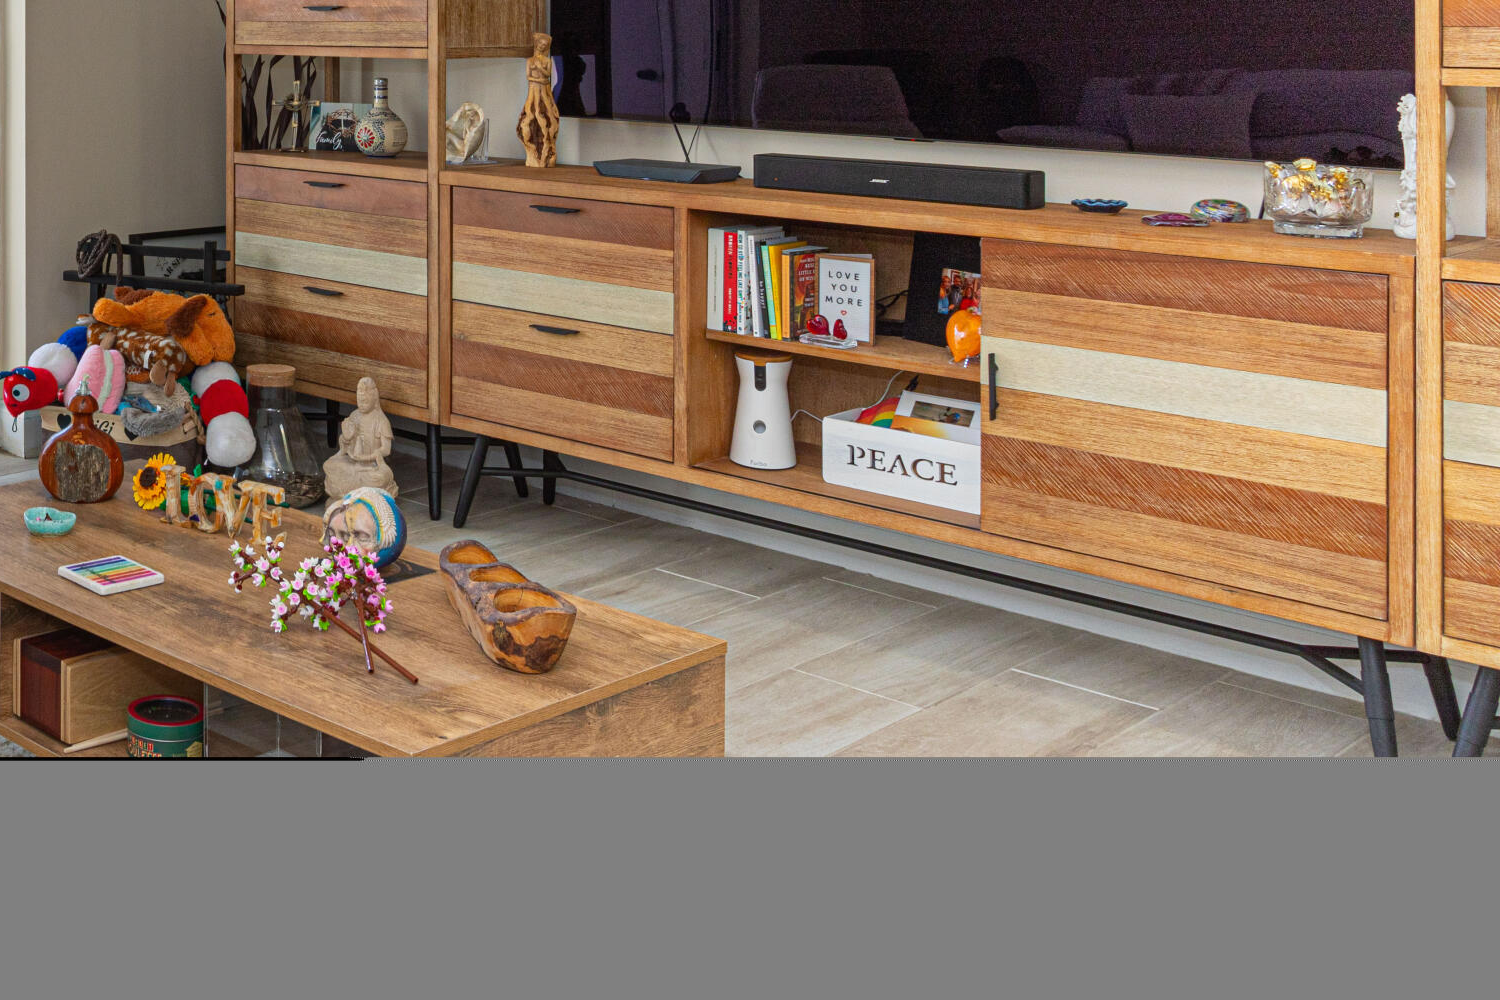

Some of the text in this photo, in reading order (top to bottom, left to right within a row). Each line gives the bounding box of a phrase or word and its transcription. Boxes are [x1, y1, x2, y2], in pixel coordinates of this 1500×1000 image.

[828, 270, 860, 281] LOVE
[831, 283, 858, 293] YOU
[825, 295, 863, 307] MORE
[846, 444, 958, 486] PEACE
[159, 464, 288, 546] LOVE
